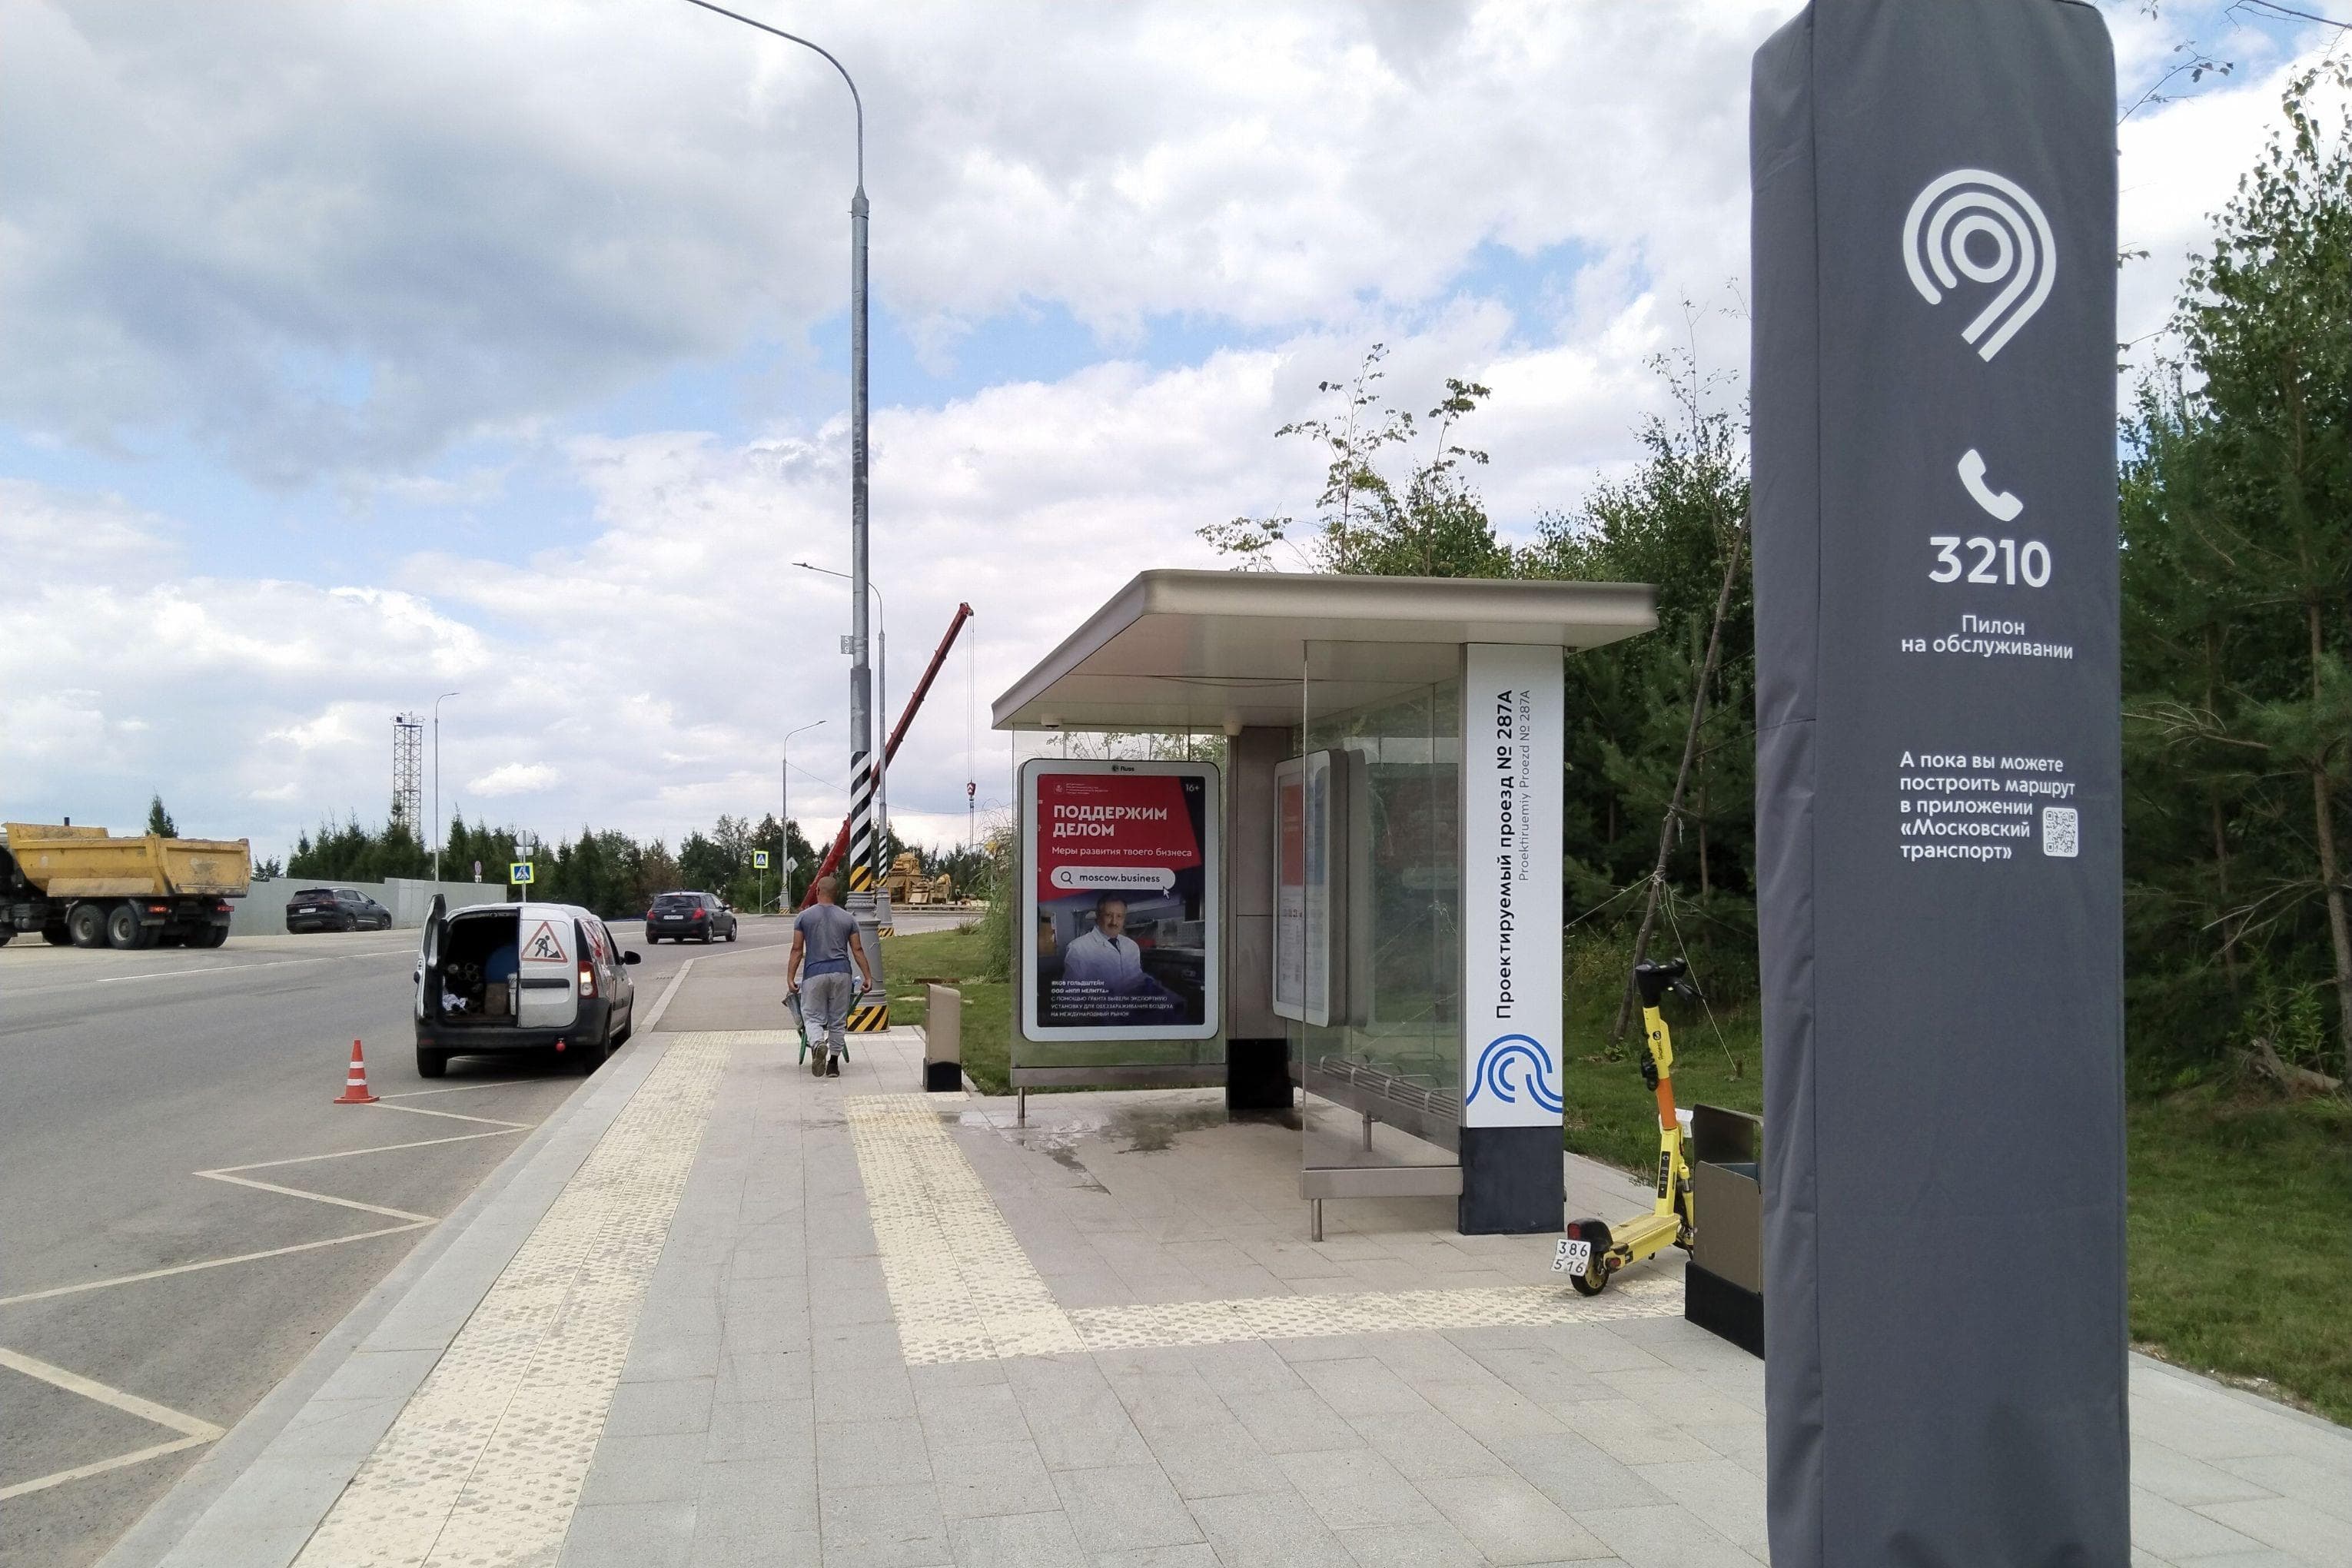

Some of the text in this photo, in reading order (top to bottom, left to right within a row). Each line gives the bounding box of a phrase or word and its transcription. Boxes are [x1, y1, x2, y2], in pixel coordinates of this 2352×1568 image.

[1928, 537, 2051, 587] 3210
[1962, 615, 2025, 636] Пилон
[1902, 634, 2073, 659] на обслуживании
[1519, 690, 1530, 722] 287A
[1519, 745, 1530, 788] Proezd
[1900, 751, 2064, 772] А пока вы можете
[1185, 783, 1200, 792] 16+
[1900, 777, 2076, 799] построить маршрут
[1054, 805, 1168, 822] ПОДДЕРЖИМ
[1900, 800, 2033, 816] в приложении
[1052, 822, 1115, 839] ДЕЛОМ
[1519, 792, 1532, 881] Proektiruemiy
[1900, 819, 2030, 837] «Московский
[1051, 847, 1078, 855] Меры
[1080, 849, 1121, 857] развития
[1155, 848, 1192, 857] бизнеса
[1496, 689, 1515, 1018] Проектируемый проезд № 287А
[1900, 845, 2012, 862] транспорт»
[1079, 873, 1161, 883] moscow.business
[1559, 1241, 1587, 1257] 386
[1553, 1259, 1583, 1273] 516
